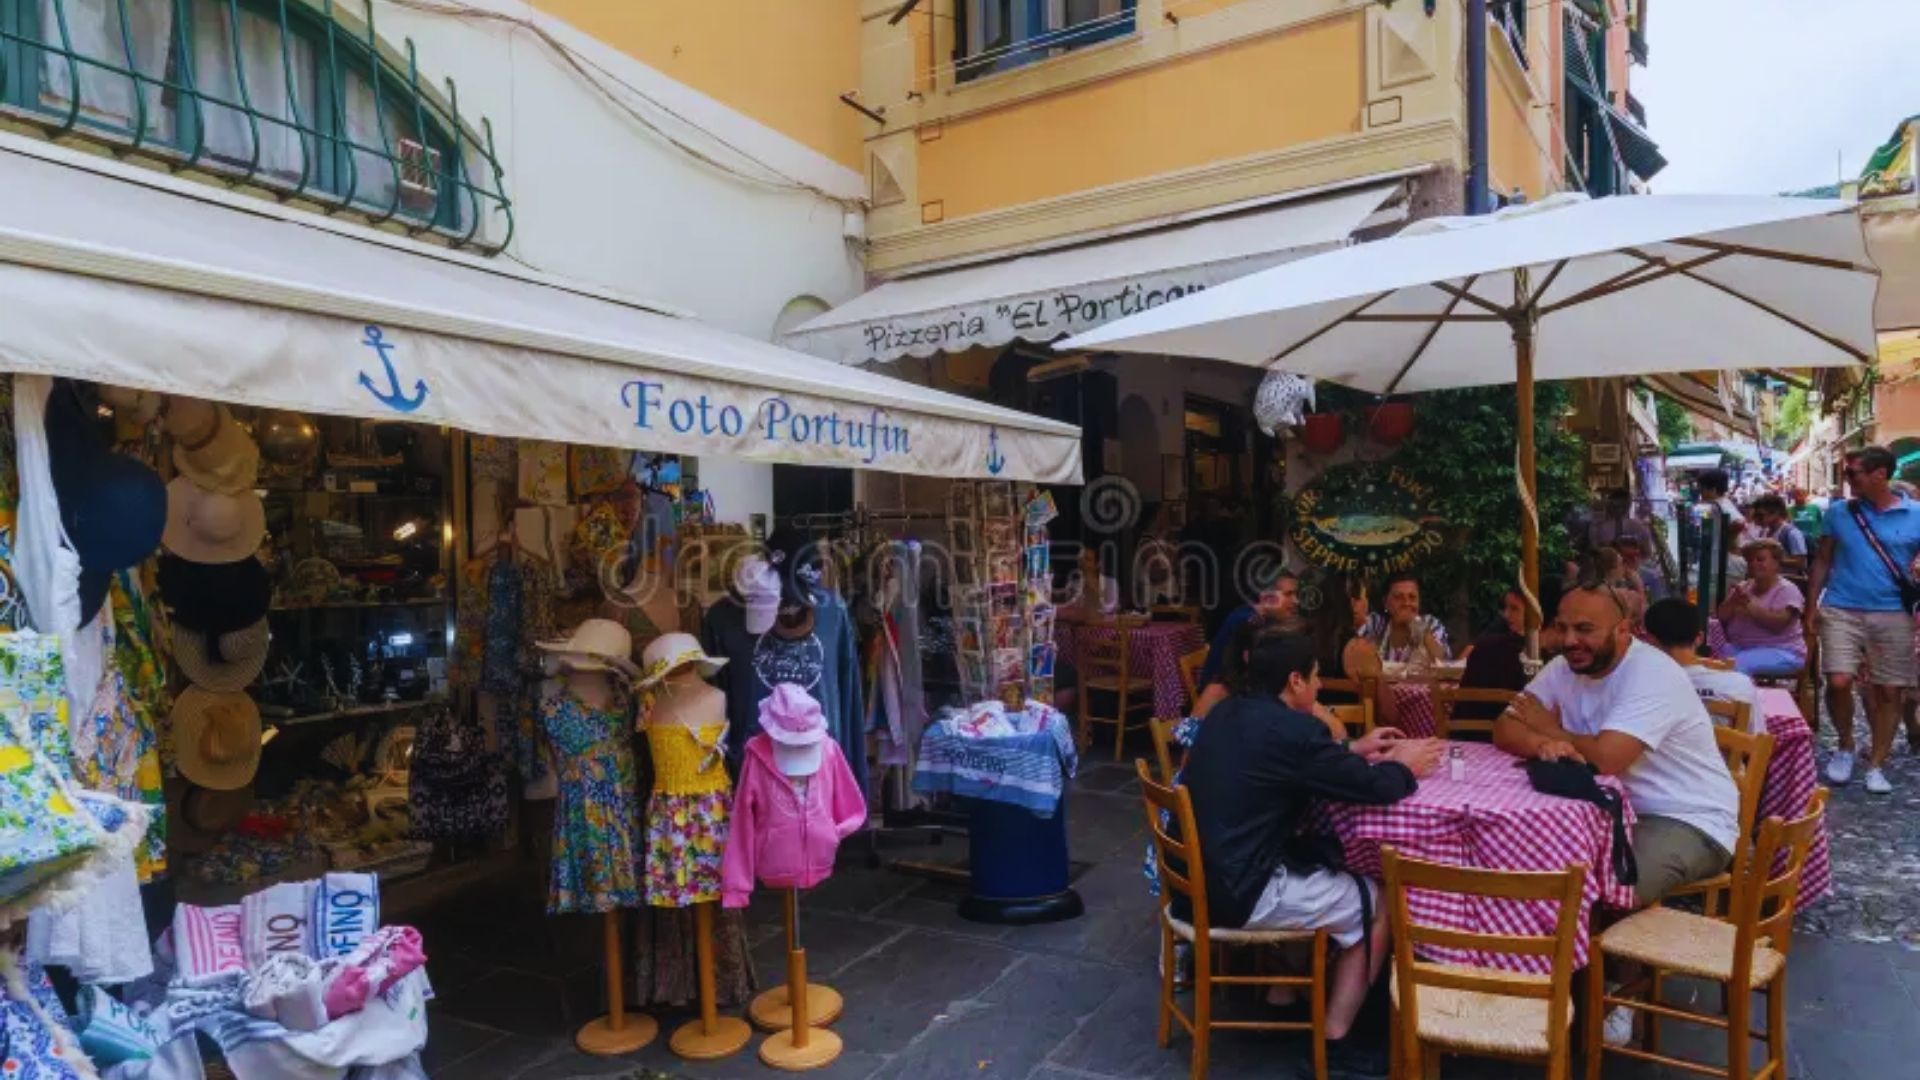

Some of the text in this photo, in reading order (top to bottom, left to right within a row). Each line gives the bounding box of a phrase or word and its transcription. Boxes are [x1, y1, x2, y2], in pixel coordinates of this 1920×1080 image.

[864, 312, 985, 352] Pizzeria
[621, 381, 911, 464] Foto Portufin
[330, 890, 372, 956] FINO
